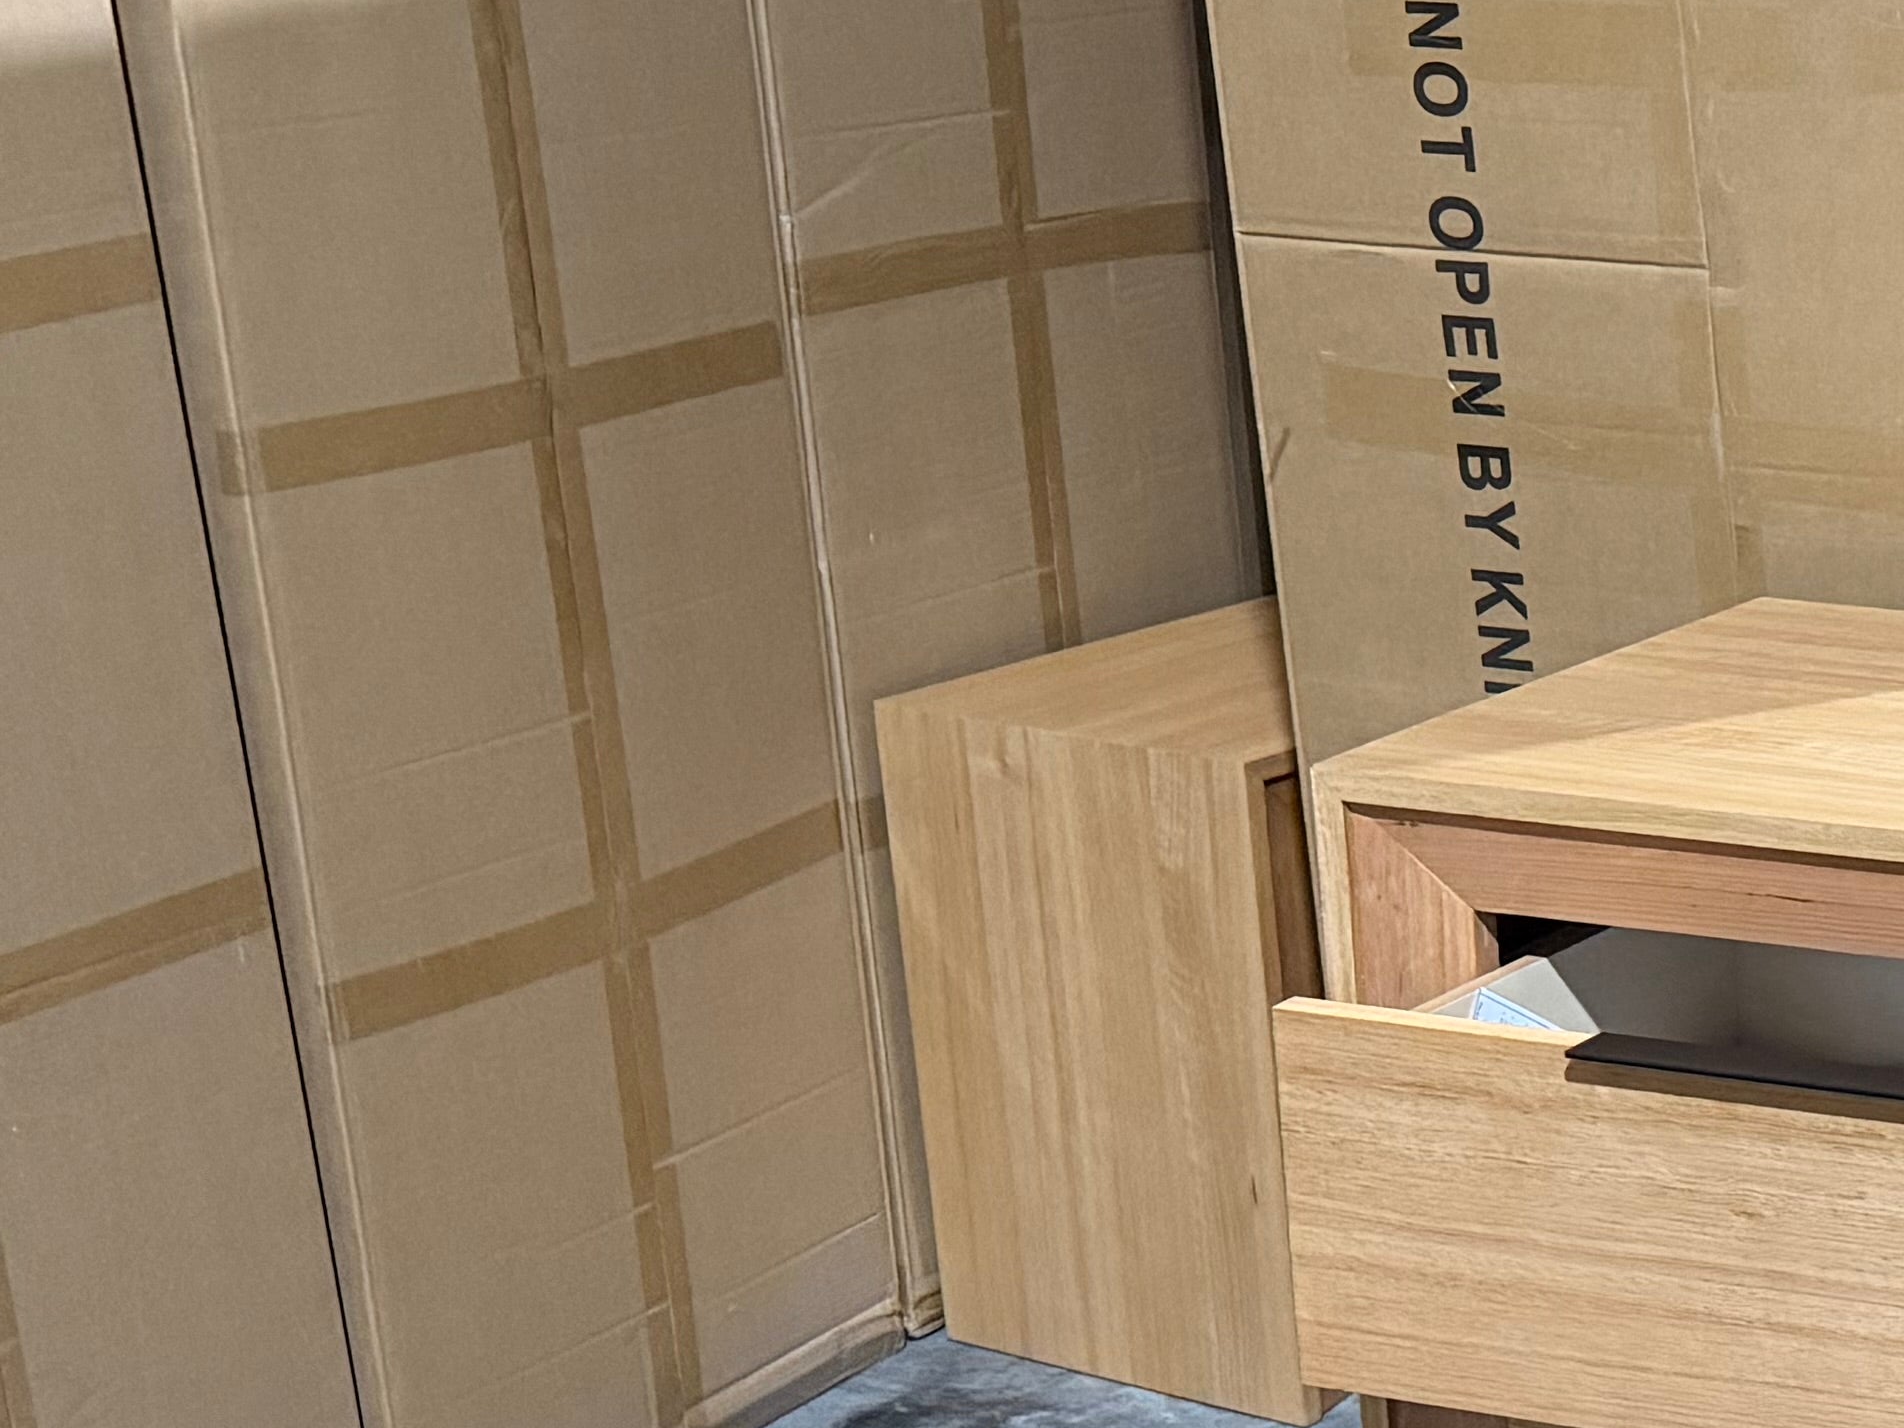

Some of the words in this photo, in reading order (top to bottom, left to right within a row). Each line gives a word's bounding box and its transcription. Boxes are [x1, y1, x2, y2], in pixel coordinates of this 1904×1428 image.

[1405, 0, 1477, 172] NOT
[1429, 195, 1505, 417] OPEN
[1457, 443, 1520, 550] BY
